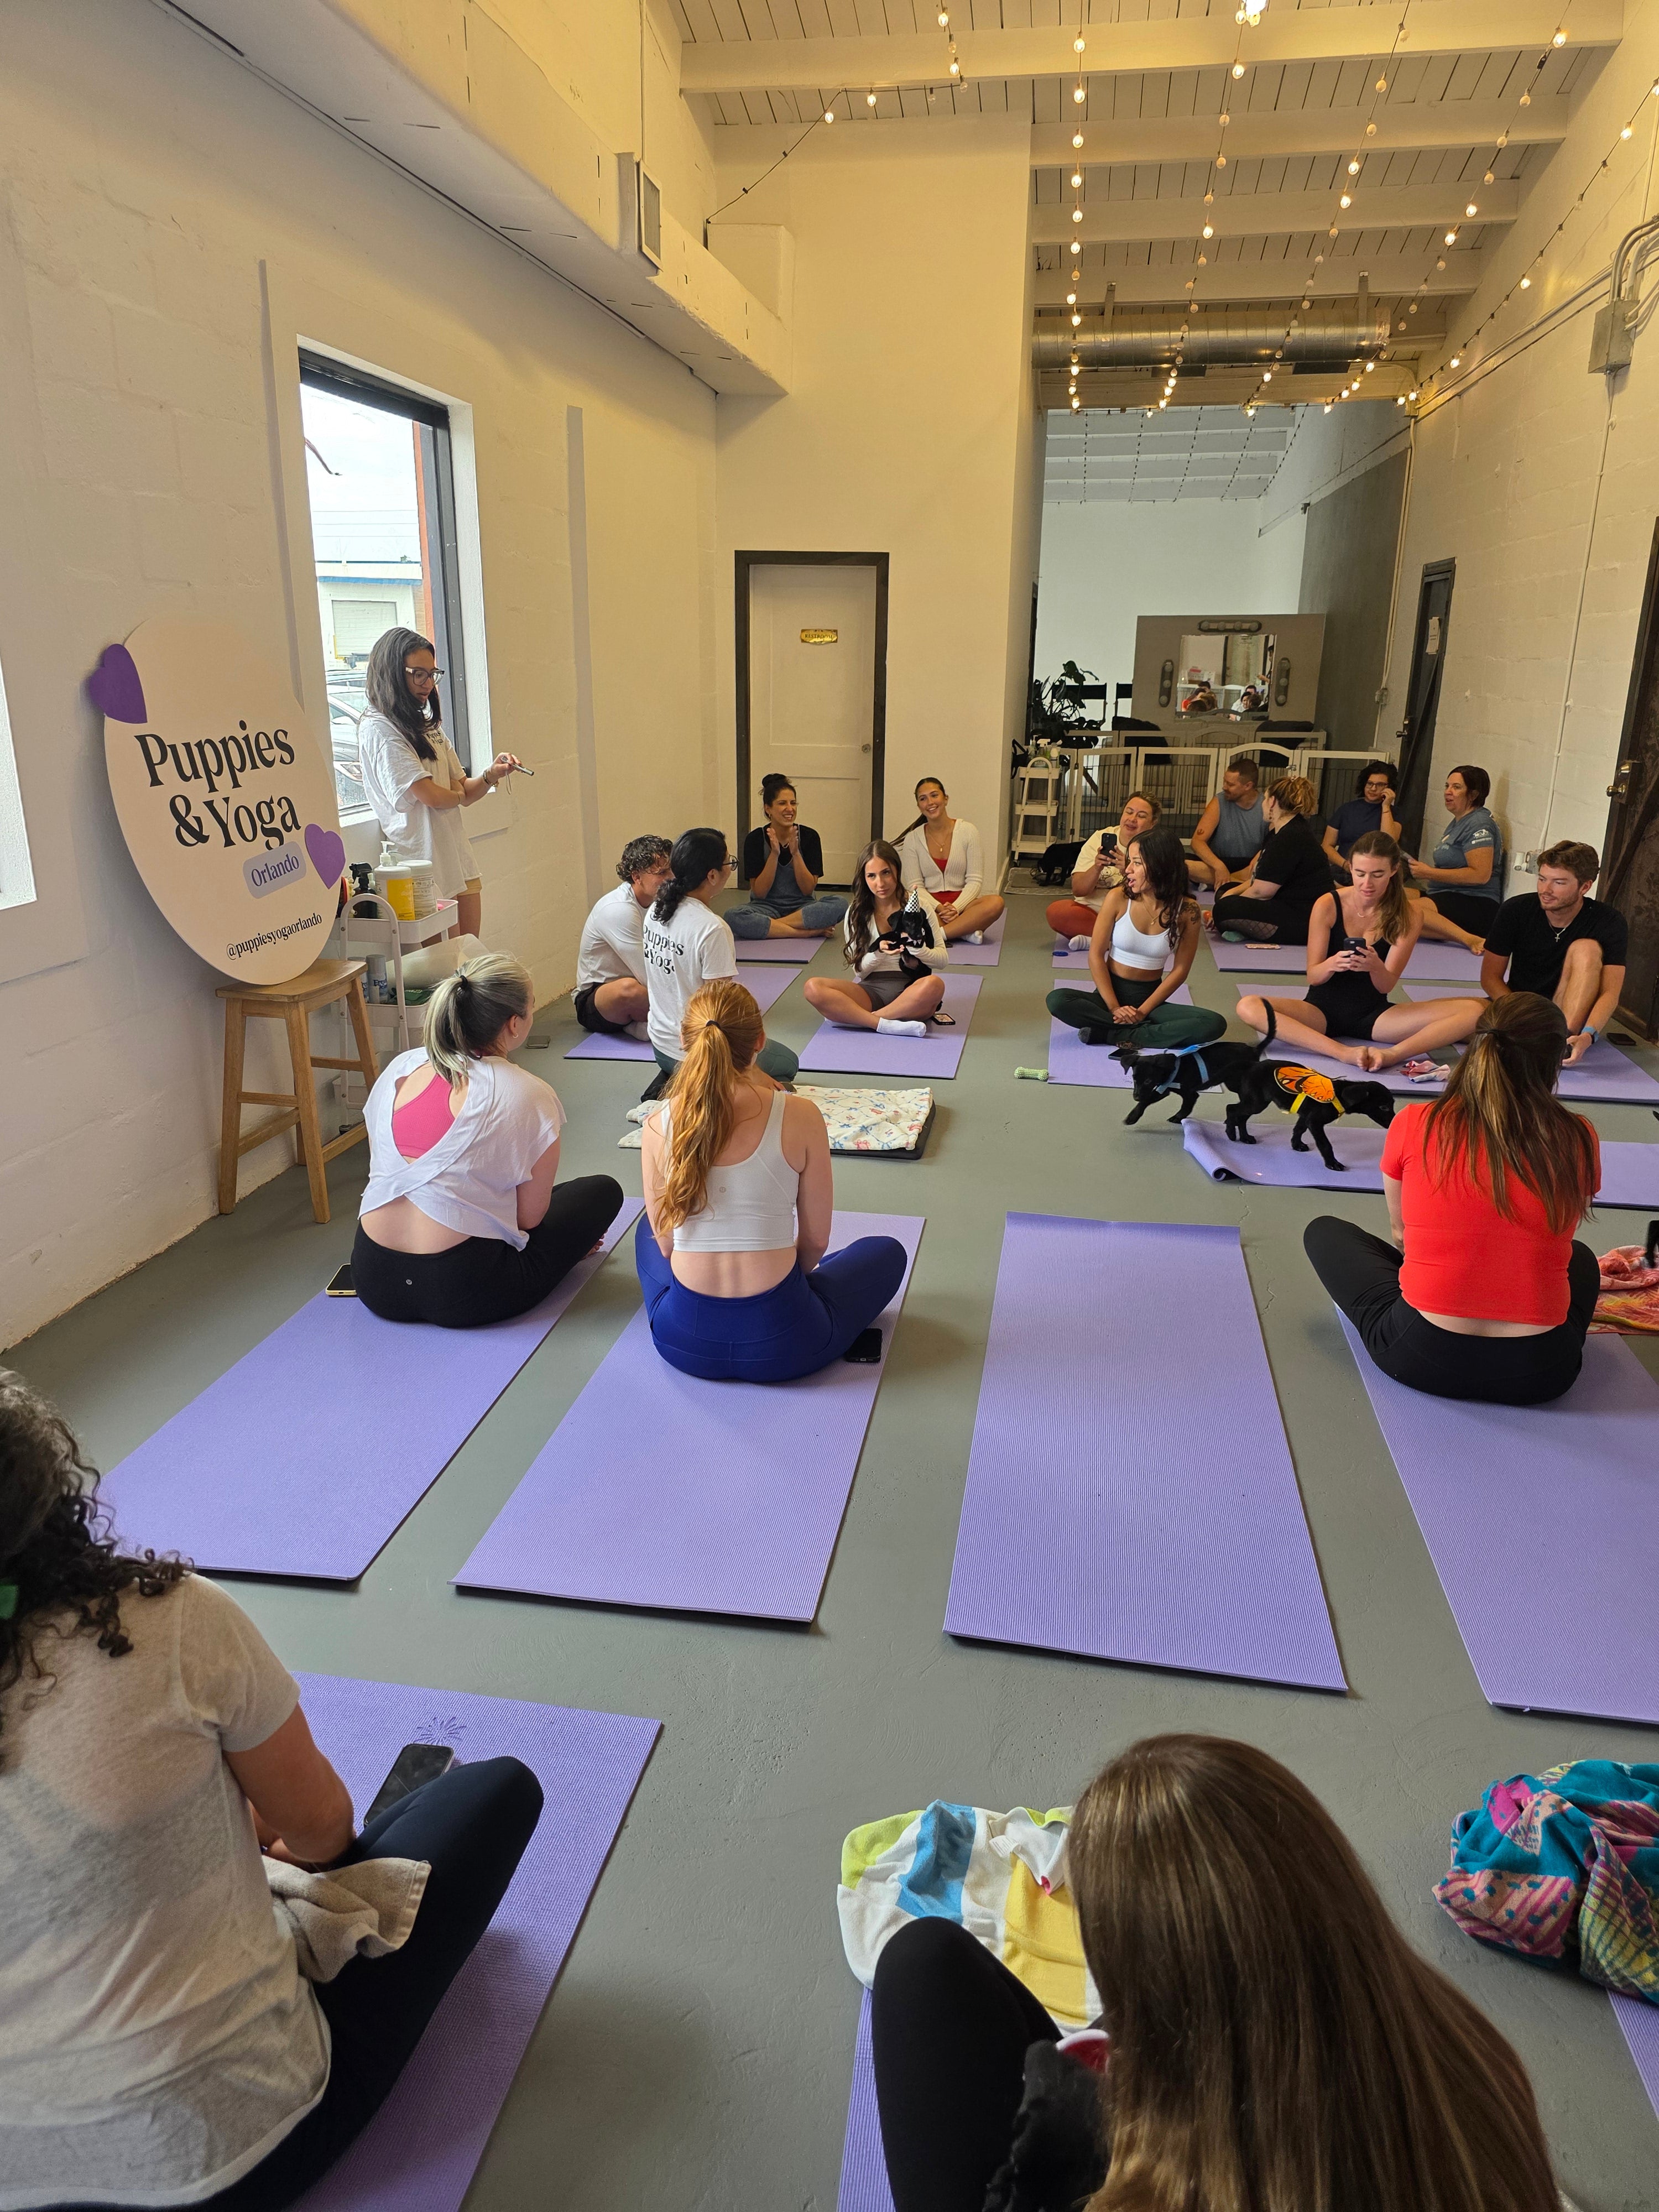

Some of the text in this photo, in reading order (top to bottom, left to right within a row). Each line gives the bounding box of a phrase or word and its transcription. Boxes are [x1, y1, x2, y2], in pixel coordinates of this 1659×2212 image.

[133, 719, 295, 793] Puppies
[251, 853, 299, 887] Orlando
[226, 912, 322, 961] @puppiesyogaorlando
